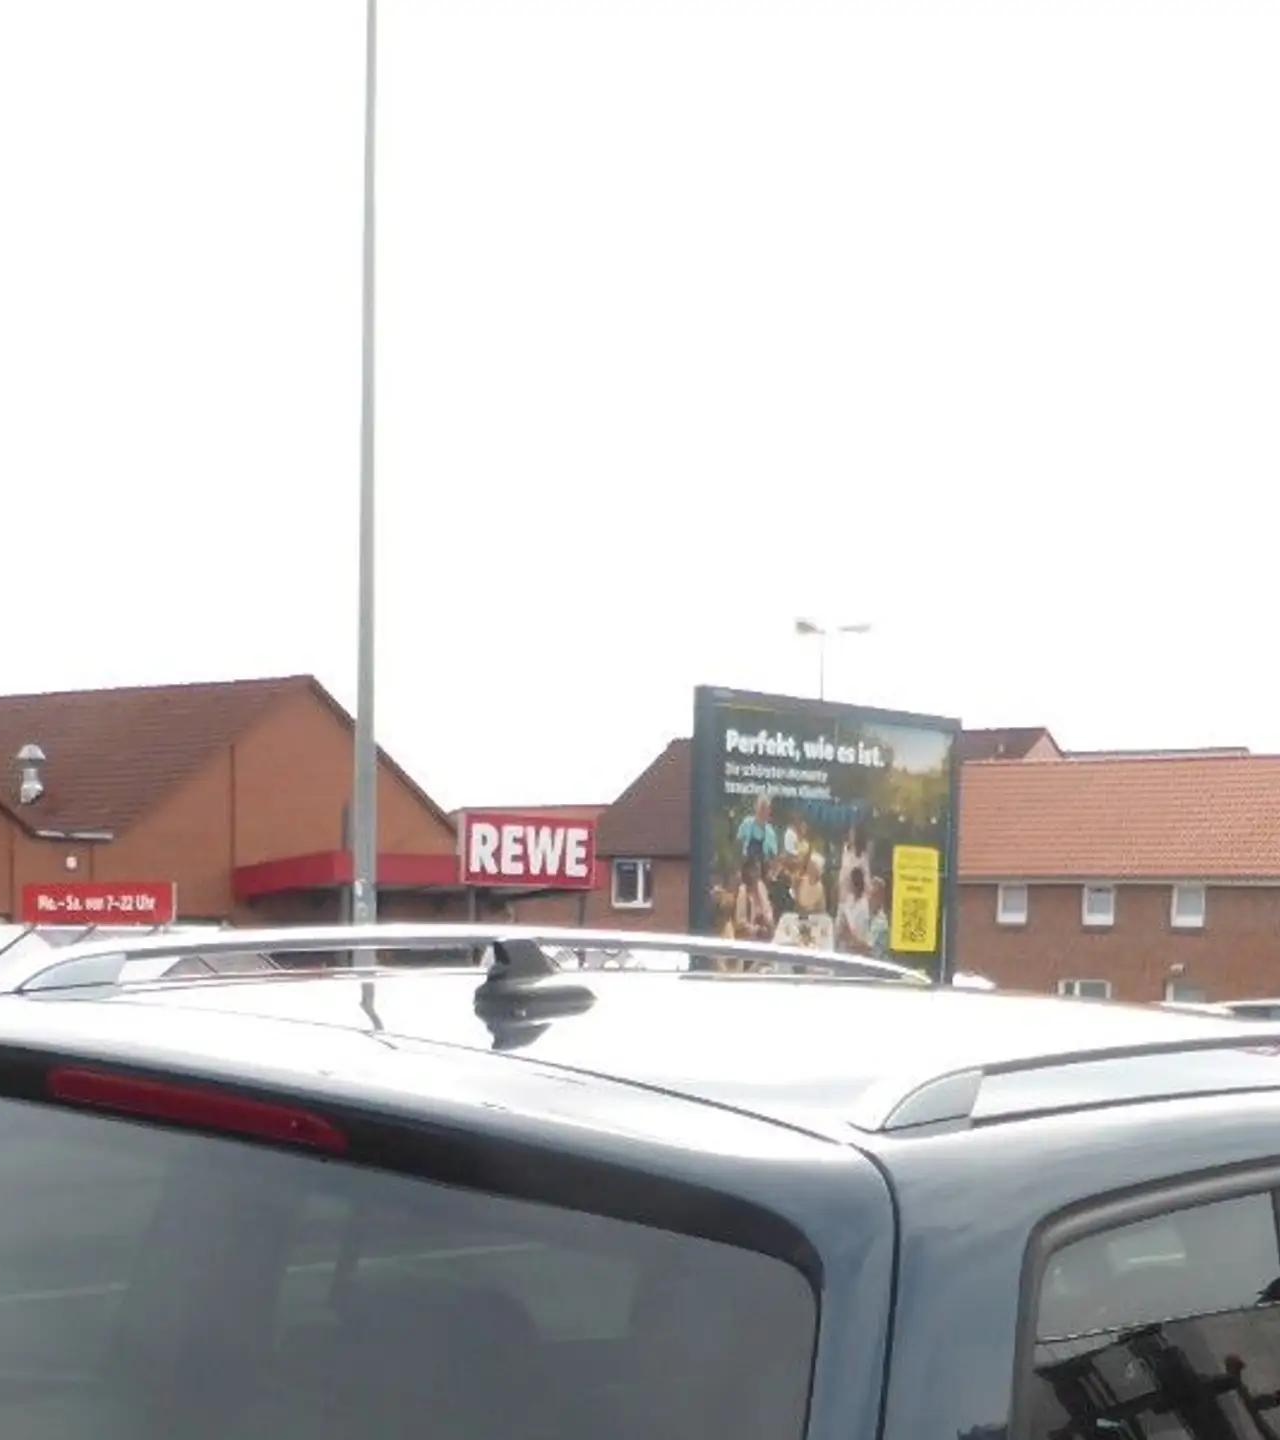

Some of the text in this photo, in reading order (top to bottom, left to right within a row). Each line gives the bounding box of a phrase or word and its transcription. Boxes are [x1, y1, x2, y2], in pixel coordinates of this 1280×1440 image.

[725, 728, 886, 767] Perfekt, wie es ist.
[469, 822, 588, 878] REWE
[136, 894, 156, 911] Uhr
